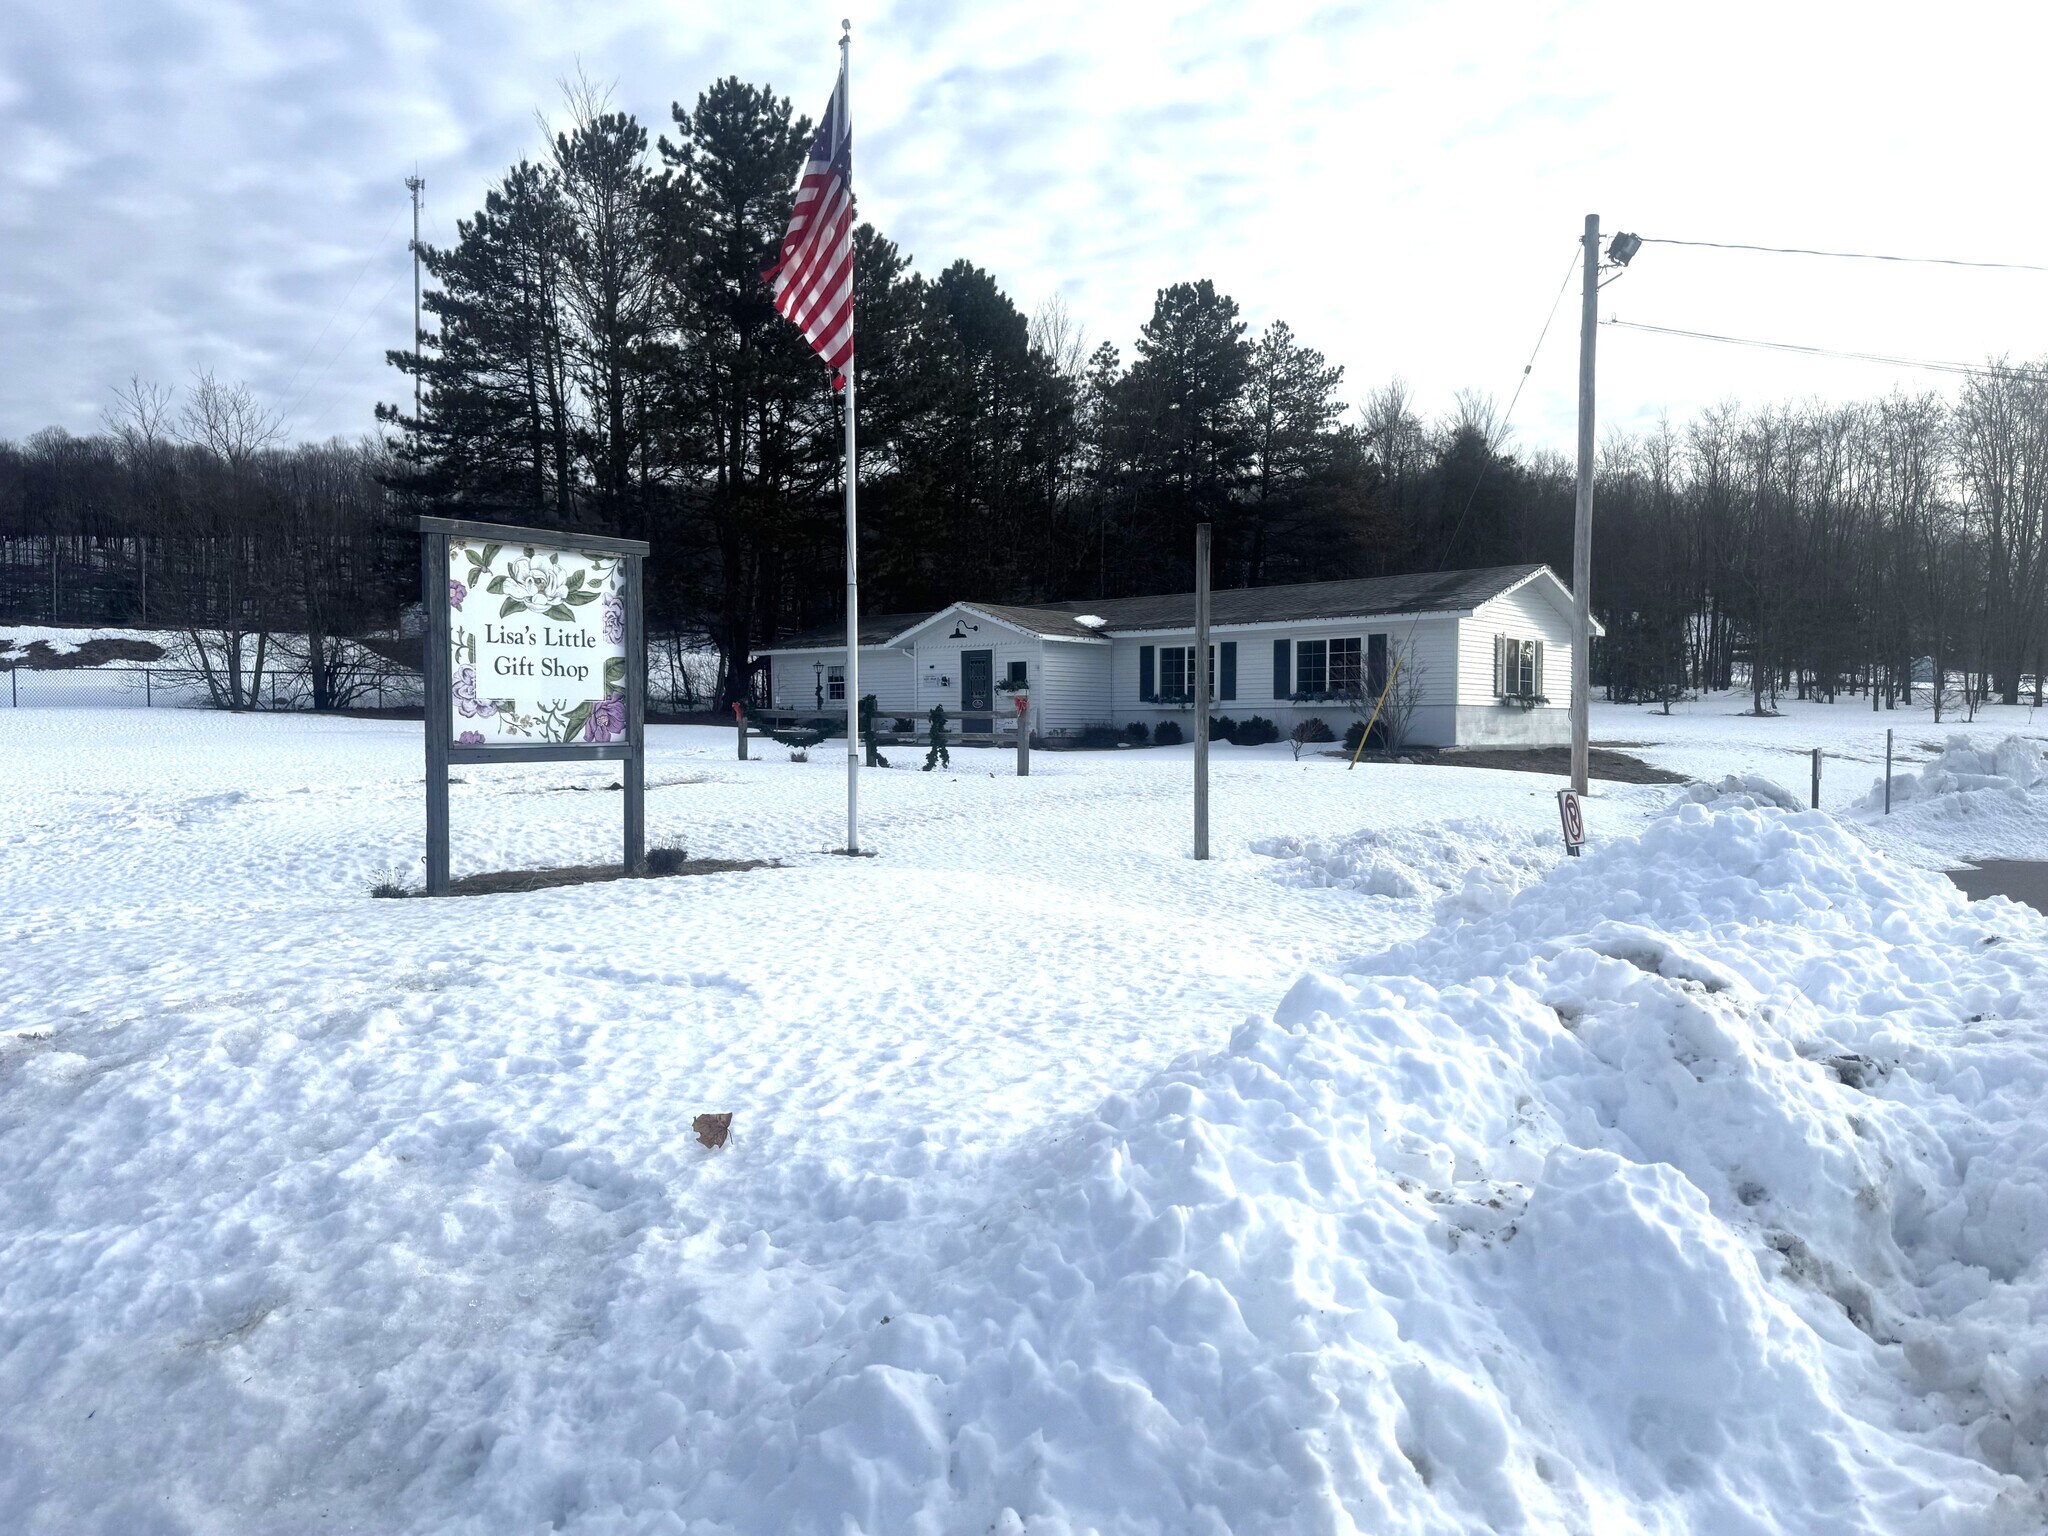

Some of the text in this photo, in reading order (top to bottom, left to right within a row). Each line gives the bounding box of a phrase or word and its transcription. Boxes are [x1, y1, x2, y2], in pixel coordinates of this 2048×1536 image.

[485, 623, 597, 649] Lisa's Little
[494, 656, 589, 682] Gift Shop
